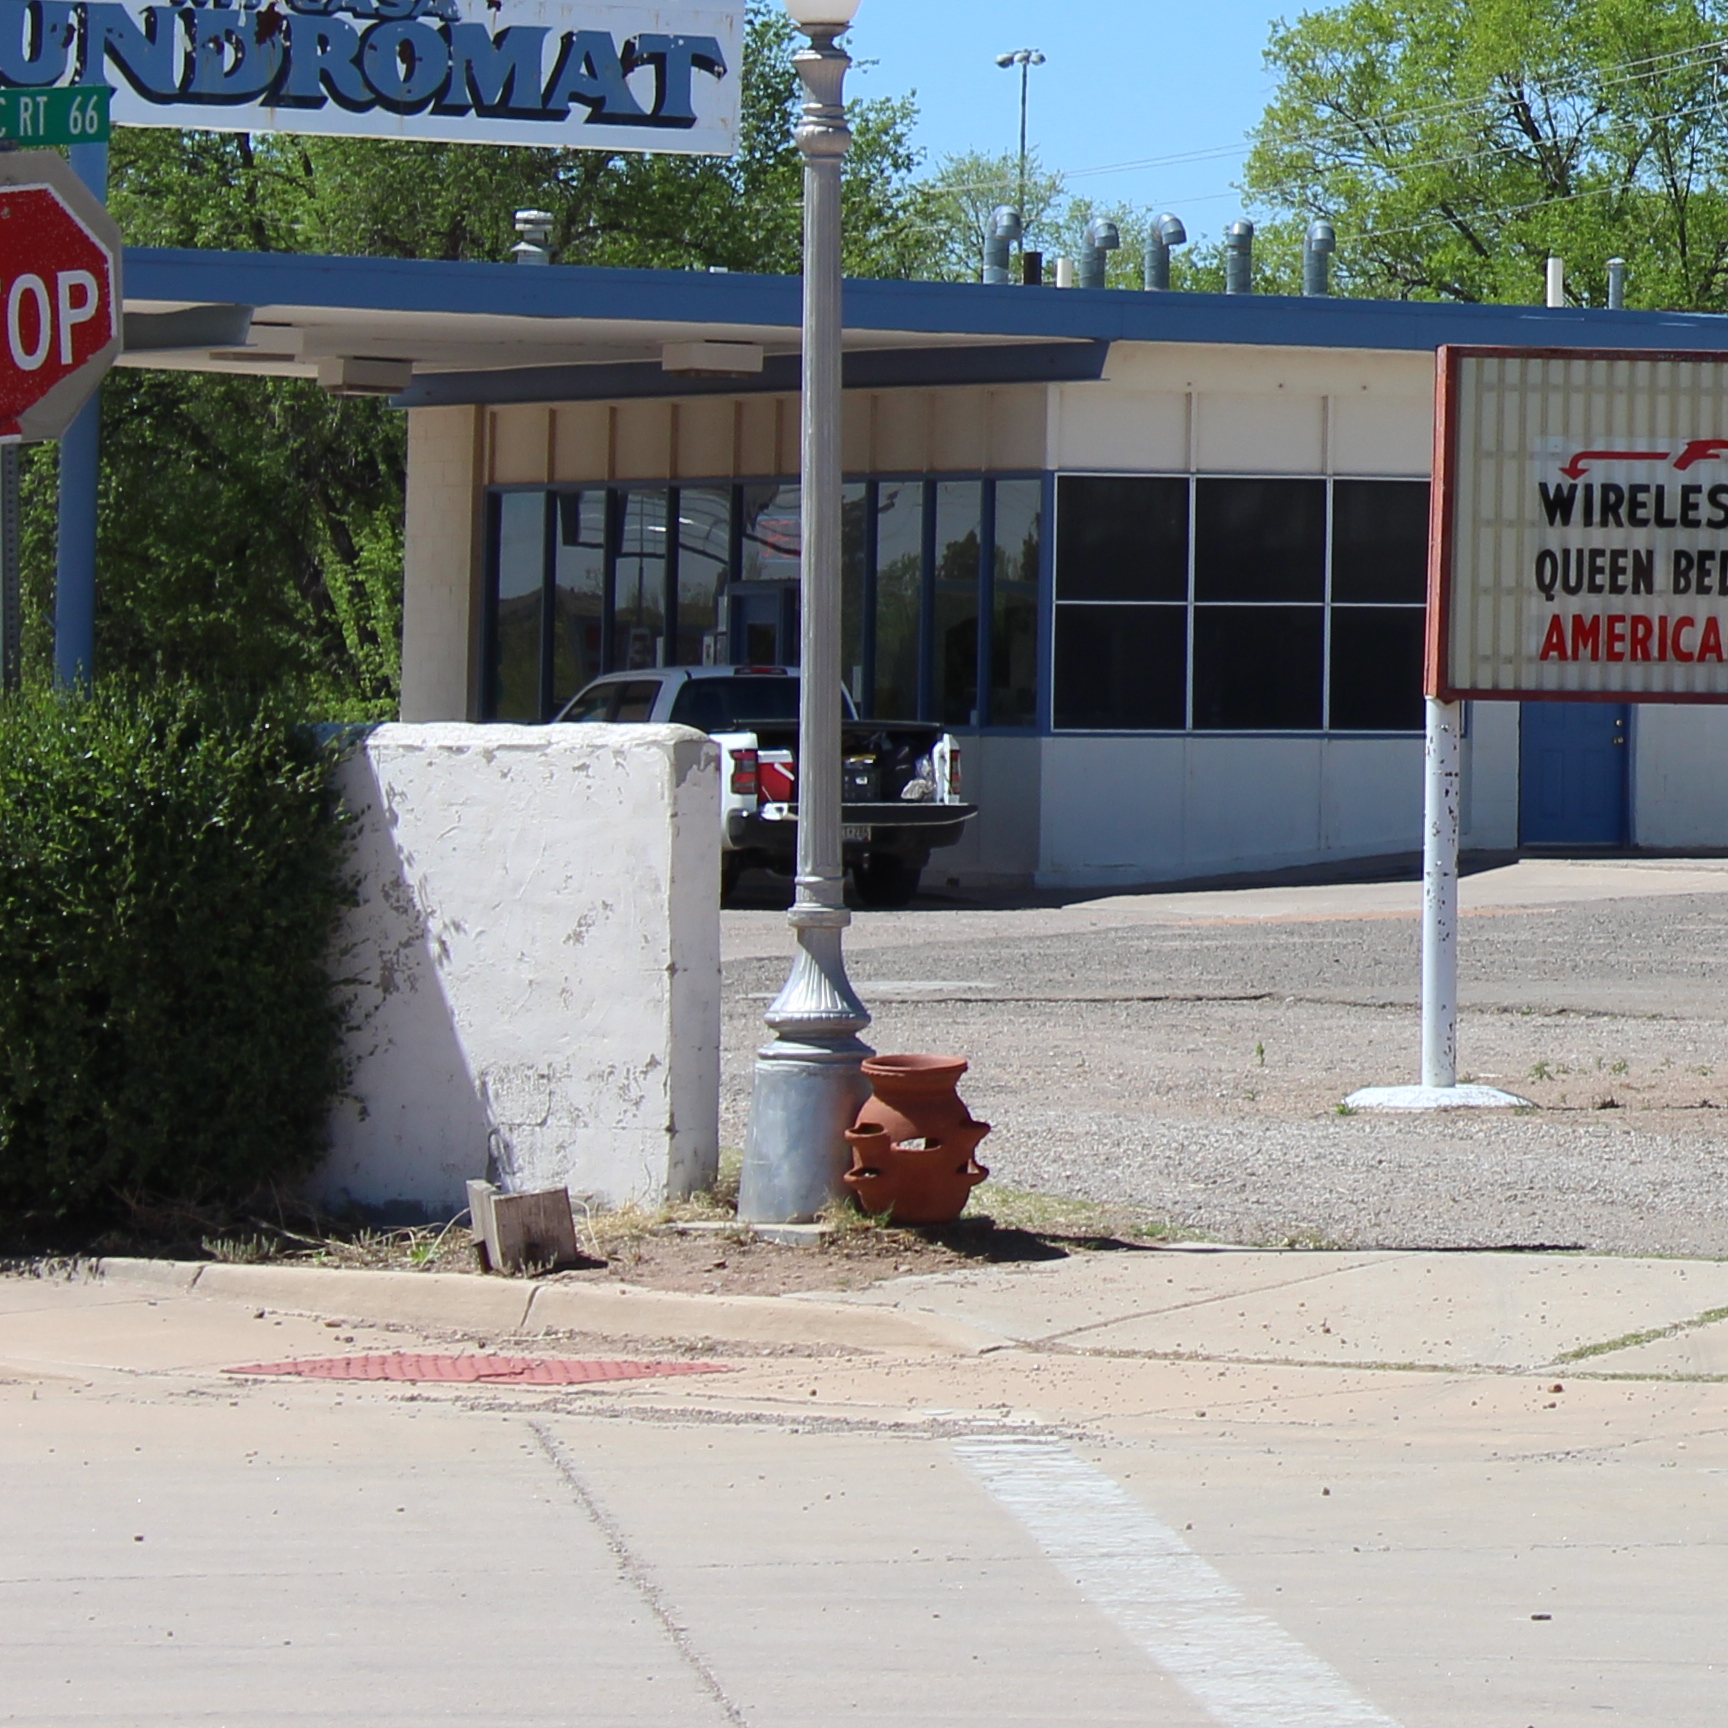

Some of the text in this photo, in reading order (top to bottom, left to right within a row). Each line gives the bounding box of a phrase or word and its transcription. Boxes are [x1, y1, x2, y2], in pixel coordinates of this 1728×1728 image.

[19, 95, 48, 136] RT
[69, 94, 99, 135] 66
[5, 270, 99, 371] OP
[1535, 548, 1654, 602] QUEEN
